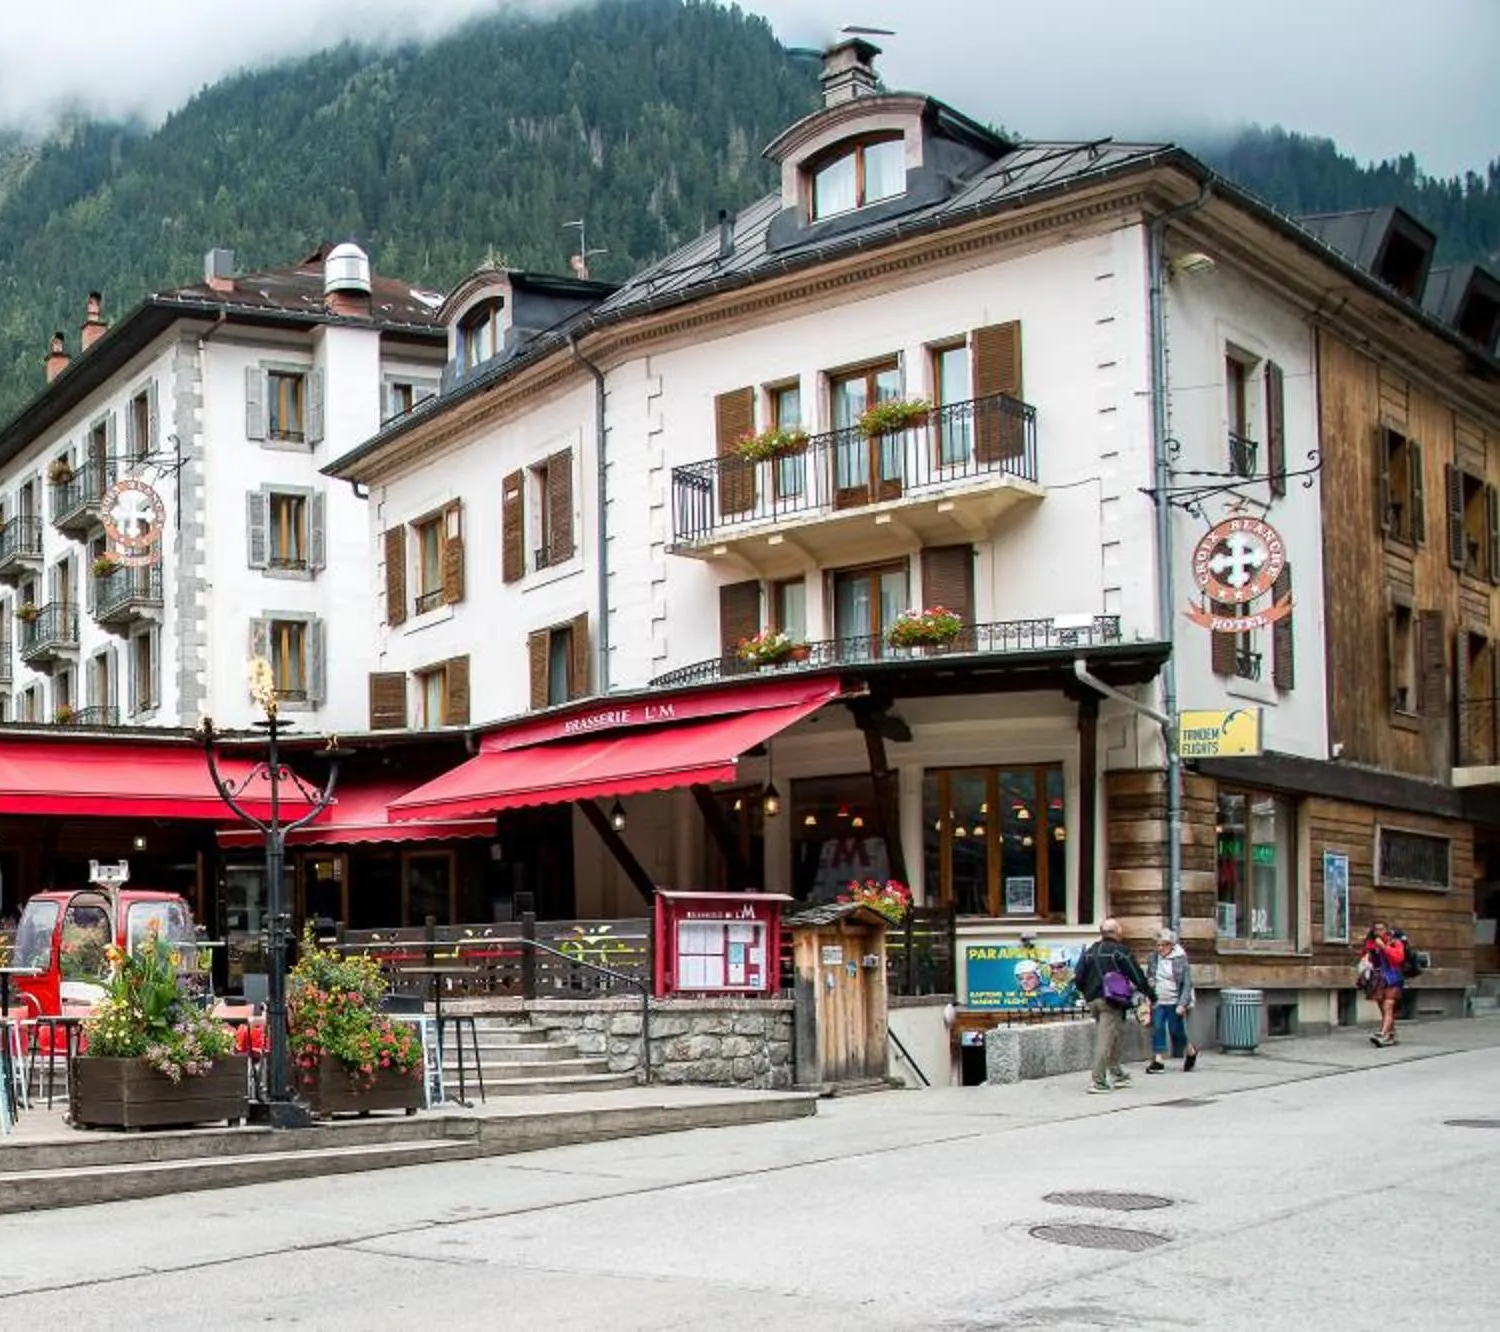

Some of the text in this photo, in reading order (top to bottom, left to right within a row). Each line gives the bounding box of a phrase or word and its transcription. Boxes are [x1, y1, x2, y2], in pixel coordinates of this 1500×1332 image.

[1196, 518, 1282, 585] CROIX BLANCHE
[1211, 615, 1267, 630] HOTEL
[564, 709, 631, 733] BRASSERIE
[1182, 727, 1220, 741] TANDEM
[1181, 741, 1219, 755] FLIGHTS
